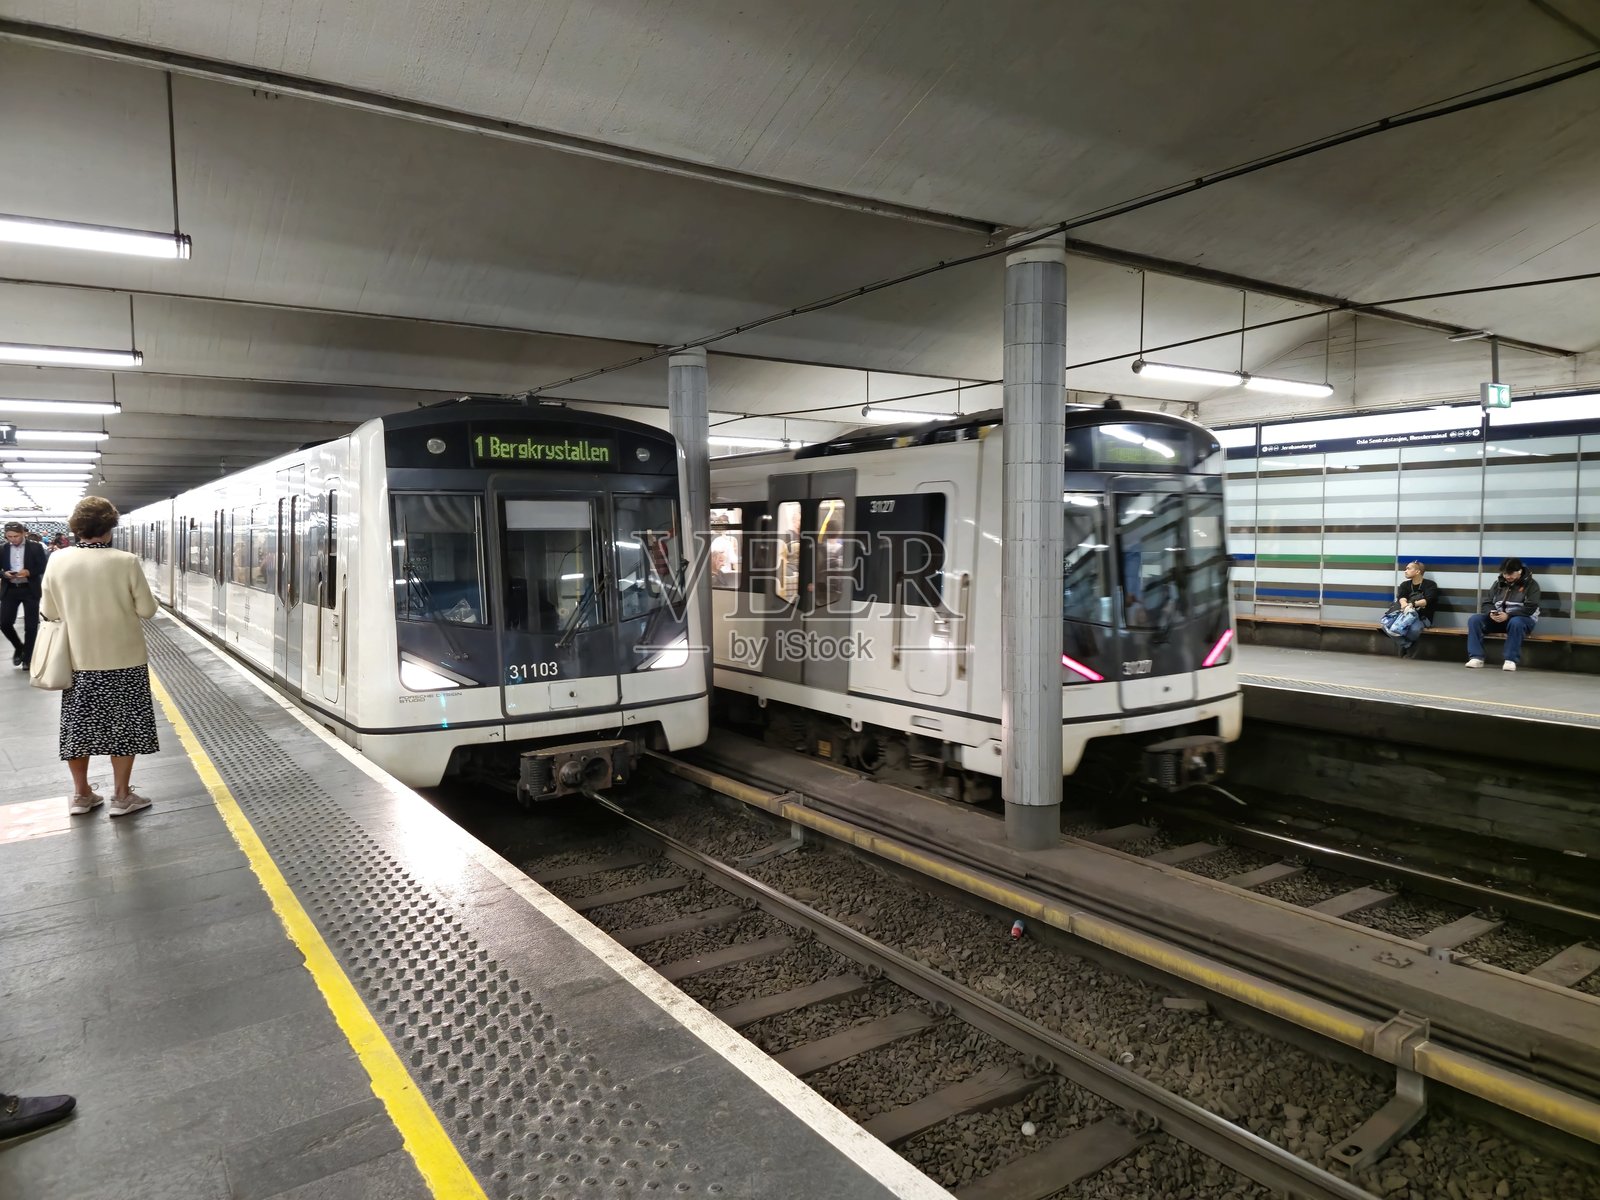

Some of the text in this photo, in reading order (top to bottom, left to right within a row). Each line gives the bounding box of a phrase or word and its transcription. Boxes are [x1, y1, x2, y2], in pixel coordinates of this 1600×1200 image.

[475, 435, 609, 462] 1 Bergkrystallen
[509, 661, 558, 679] 31103
